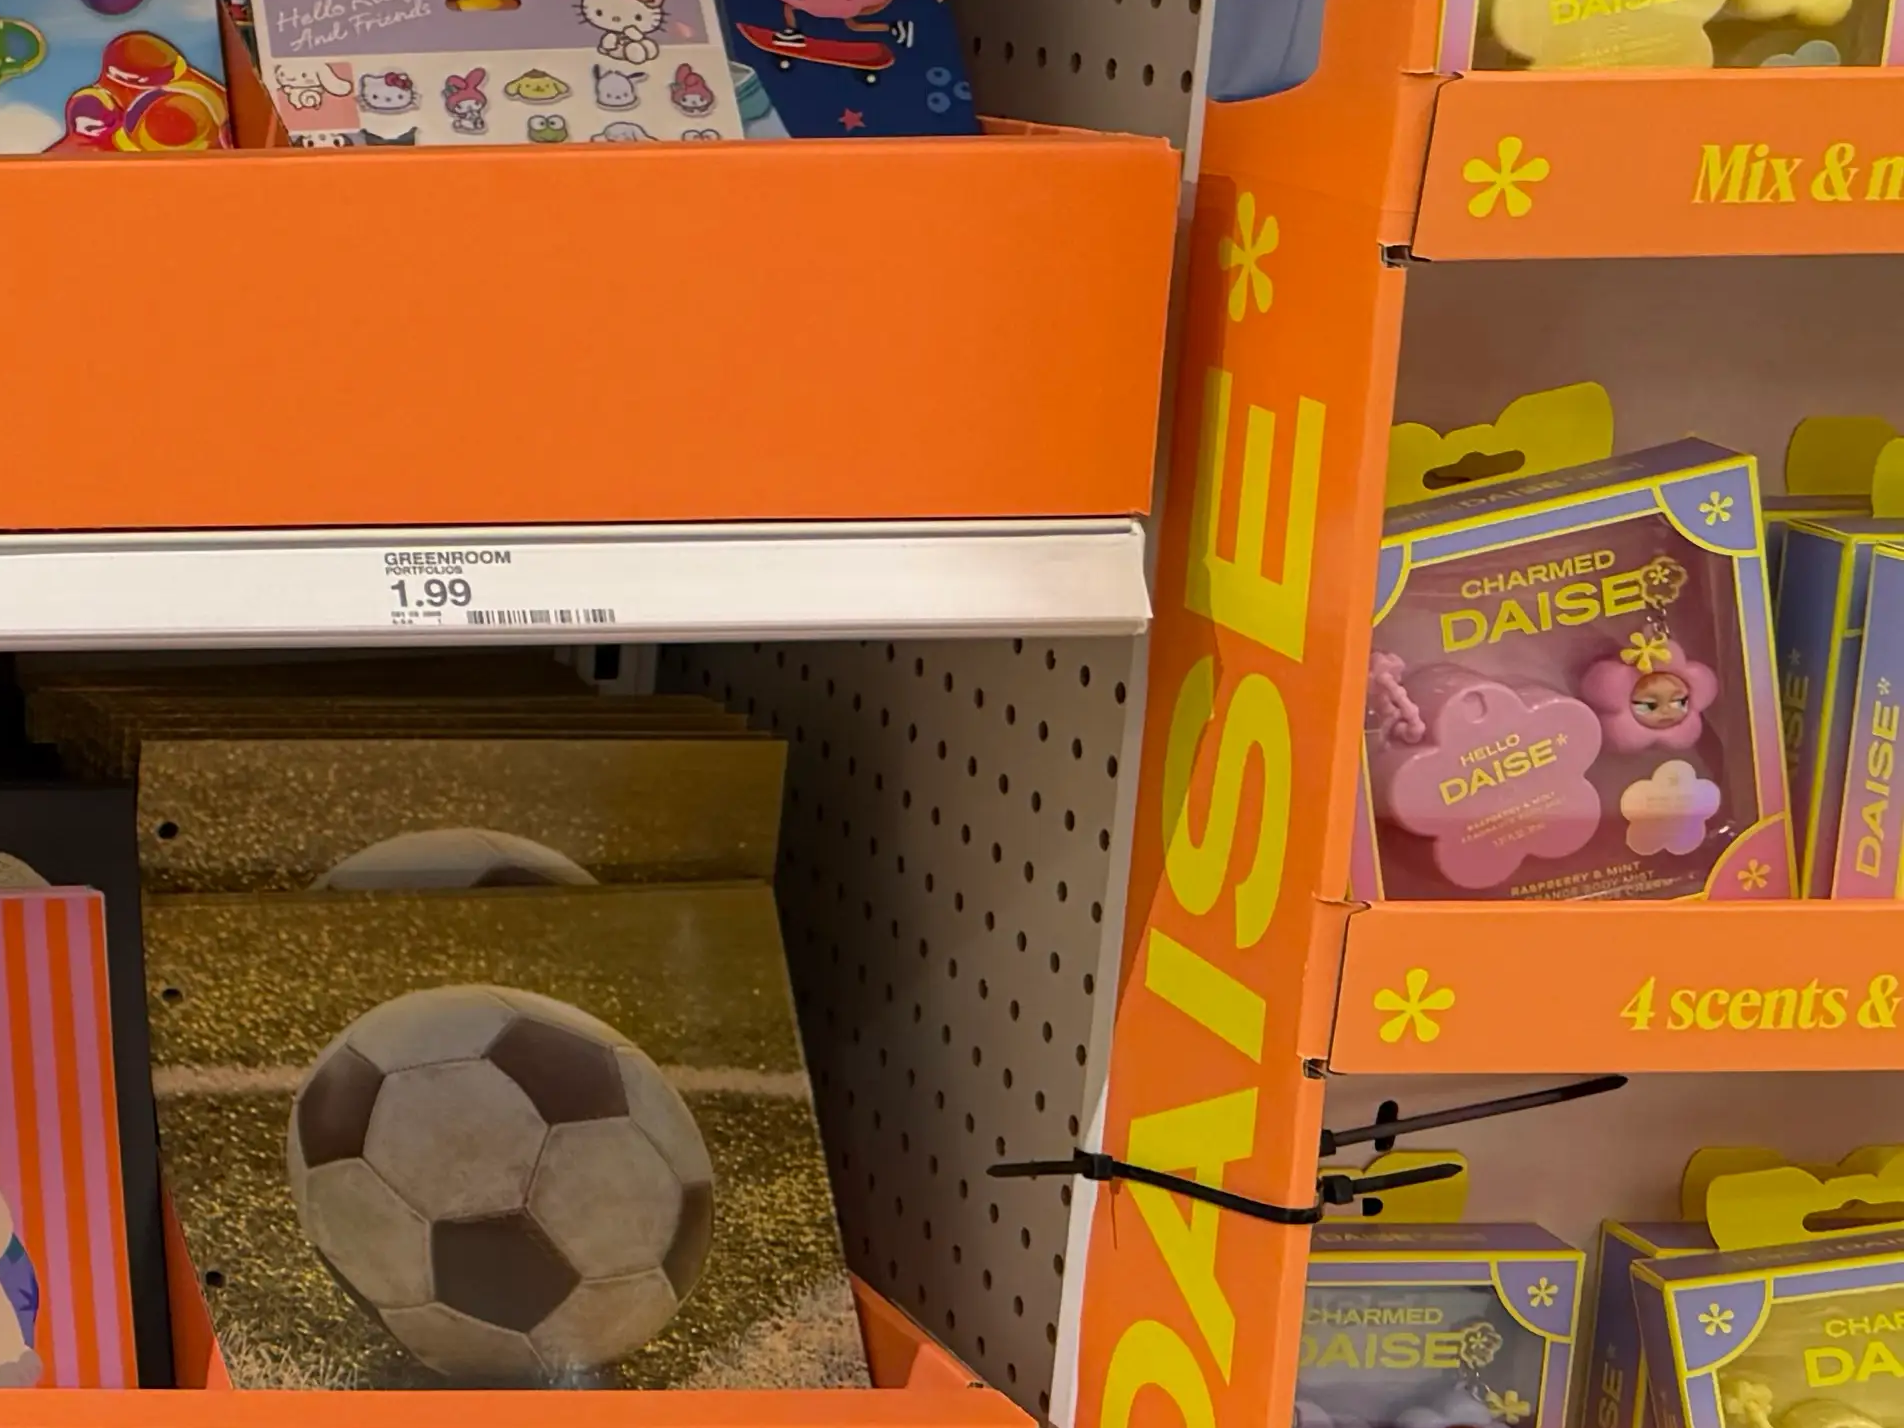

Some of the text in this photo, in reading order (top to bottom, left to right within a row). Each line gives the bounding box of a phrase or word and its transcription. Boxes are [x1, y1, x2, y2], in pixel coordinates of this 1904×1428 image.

[290, 22, 348, 52] And
[1692, 143, 1803, 204] Mix
[1810, 142, 1859, 202] &
[384, 551, 511, 565] GREENROOM
[1461, 549, 1616, 600] CHARMED
[391, 578, 472, 607] 1.99
[1440, 570, 1646, 653] DAISE
[1460, 733, 1520, 767] HELLO
[1438, 739, 1557, 806] DAISE
[1511, 861, 1641, 897] RASPBERRY MINT
[1621, 973, 1903, 1031] 4 scents &
